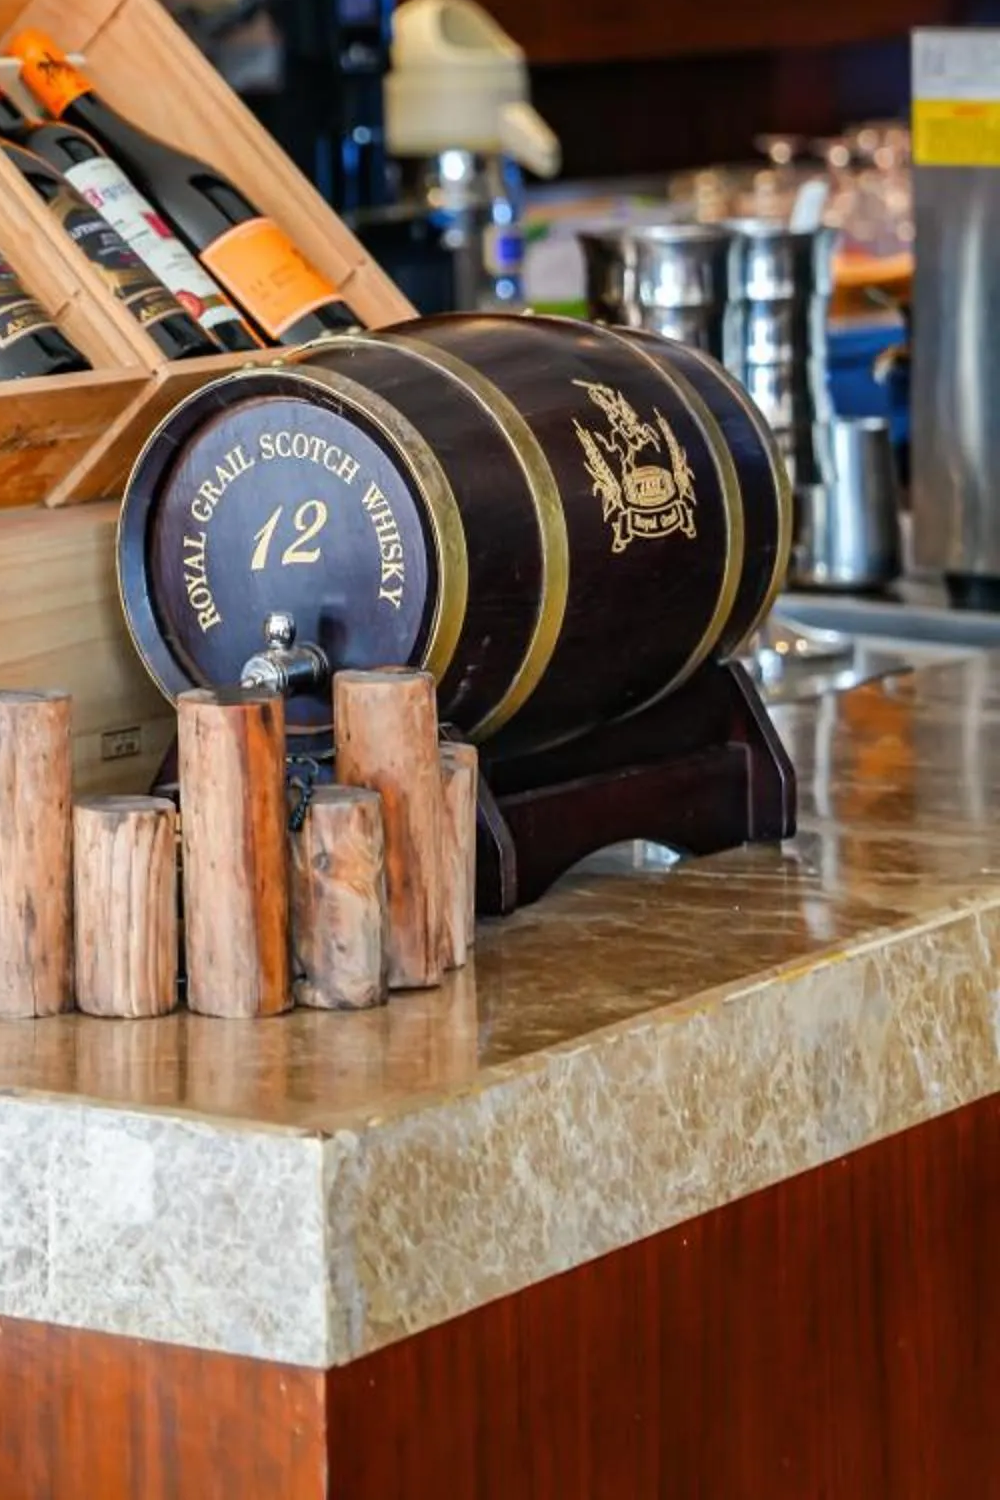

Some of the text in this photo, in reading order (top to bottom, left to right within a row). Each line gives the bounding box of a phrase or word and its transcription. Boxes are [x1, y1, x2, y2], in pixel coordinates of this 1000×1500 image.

[183, 431, 405, 634] ROYAL GRAIL SCOTCH WHISKY
[250, 499, 328, 571] 12
